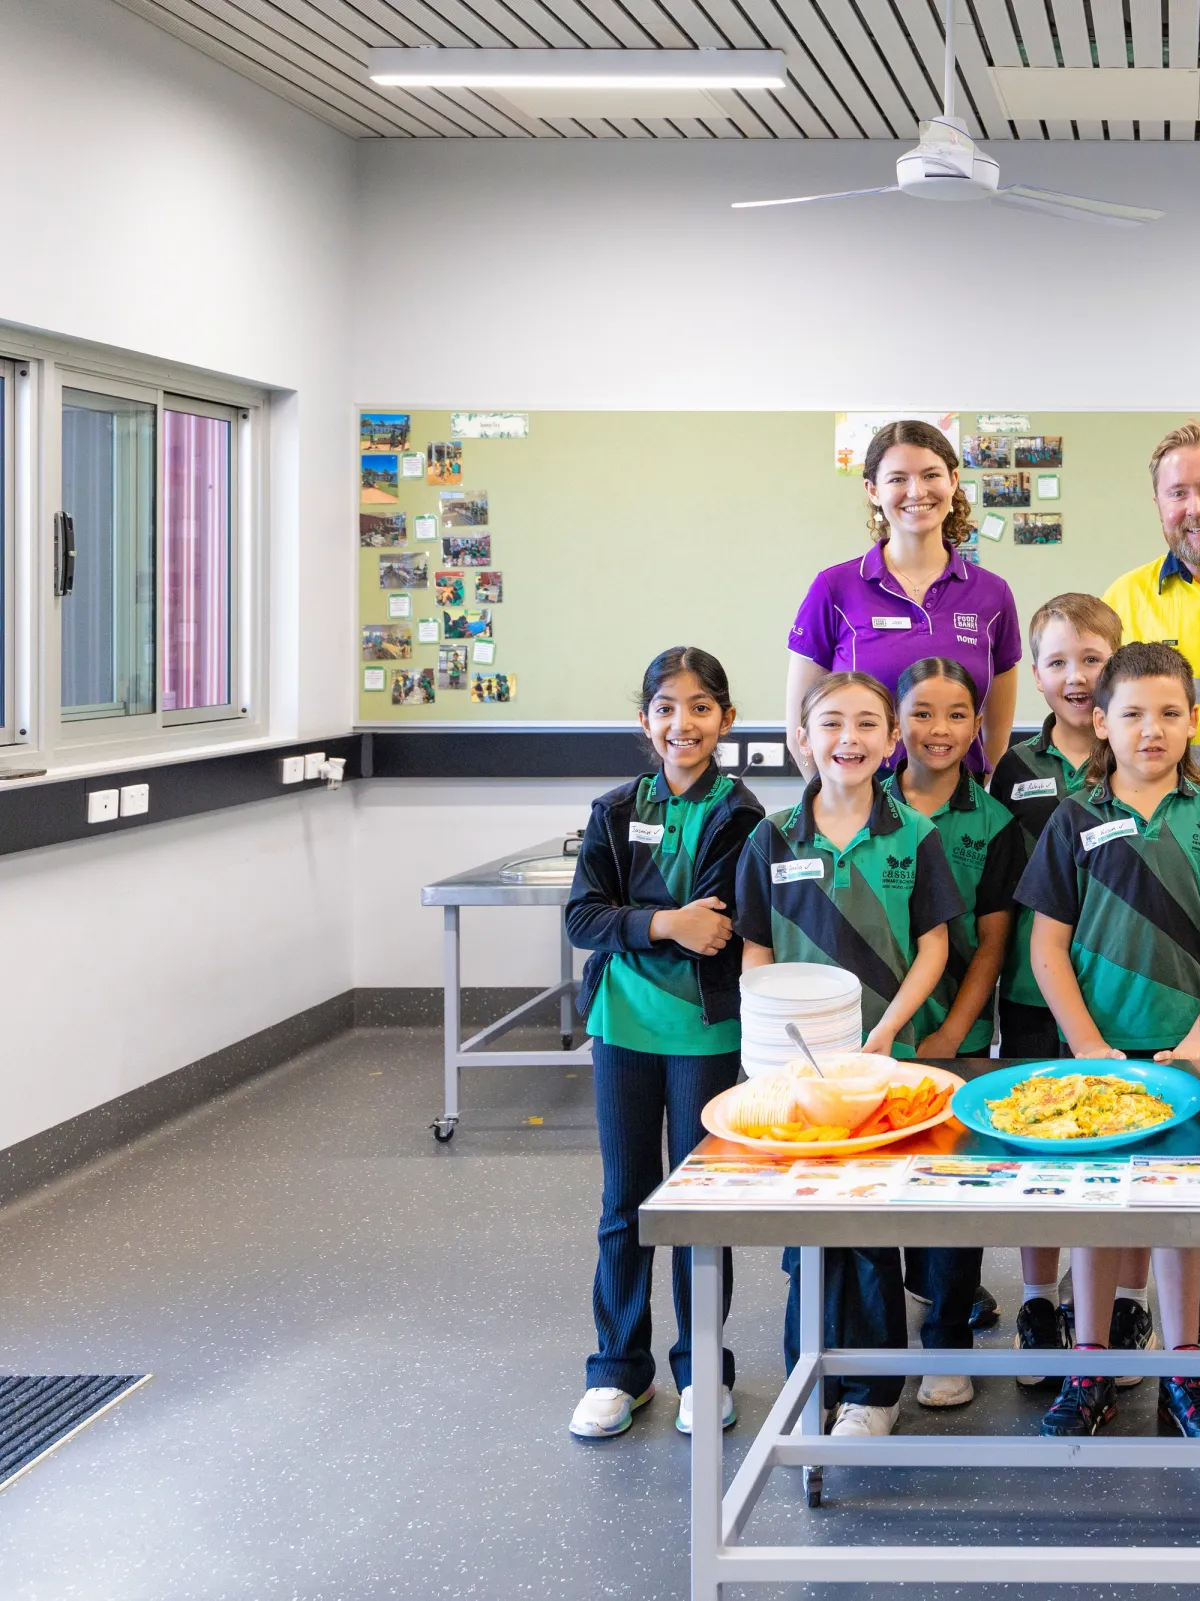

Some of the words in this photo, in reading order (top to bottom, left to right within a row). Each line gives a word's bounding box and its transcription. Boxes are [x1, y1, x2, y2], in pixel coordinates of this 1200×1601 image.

[957, 615, 975, 624] FOOD
[957, 621, 975, 629] BANK
[952, 846, 986, 862] cassia
